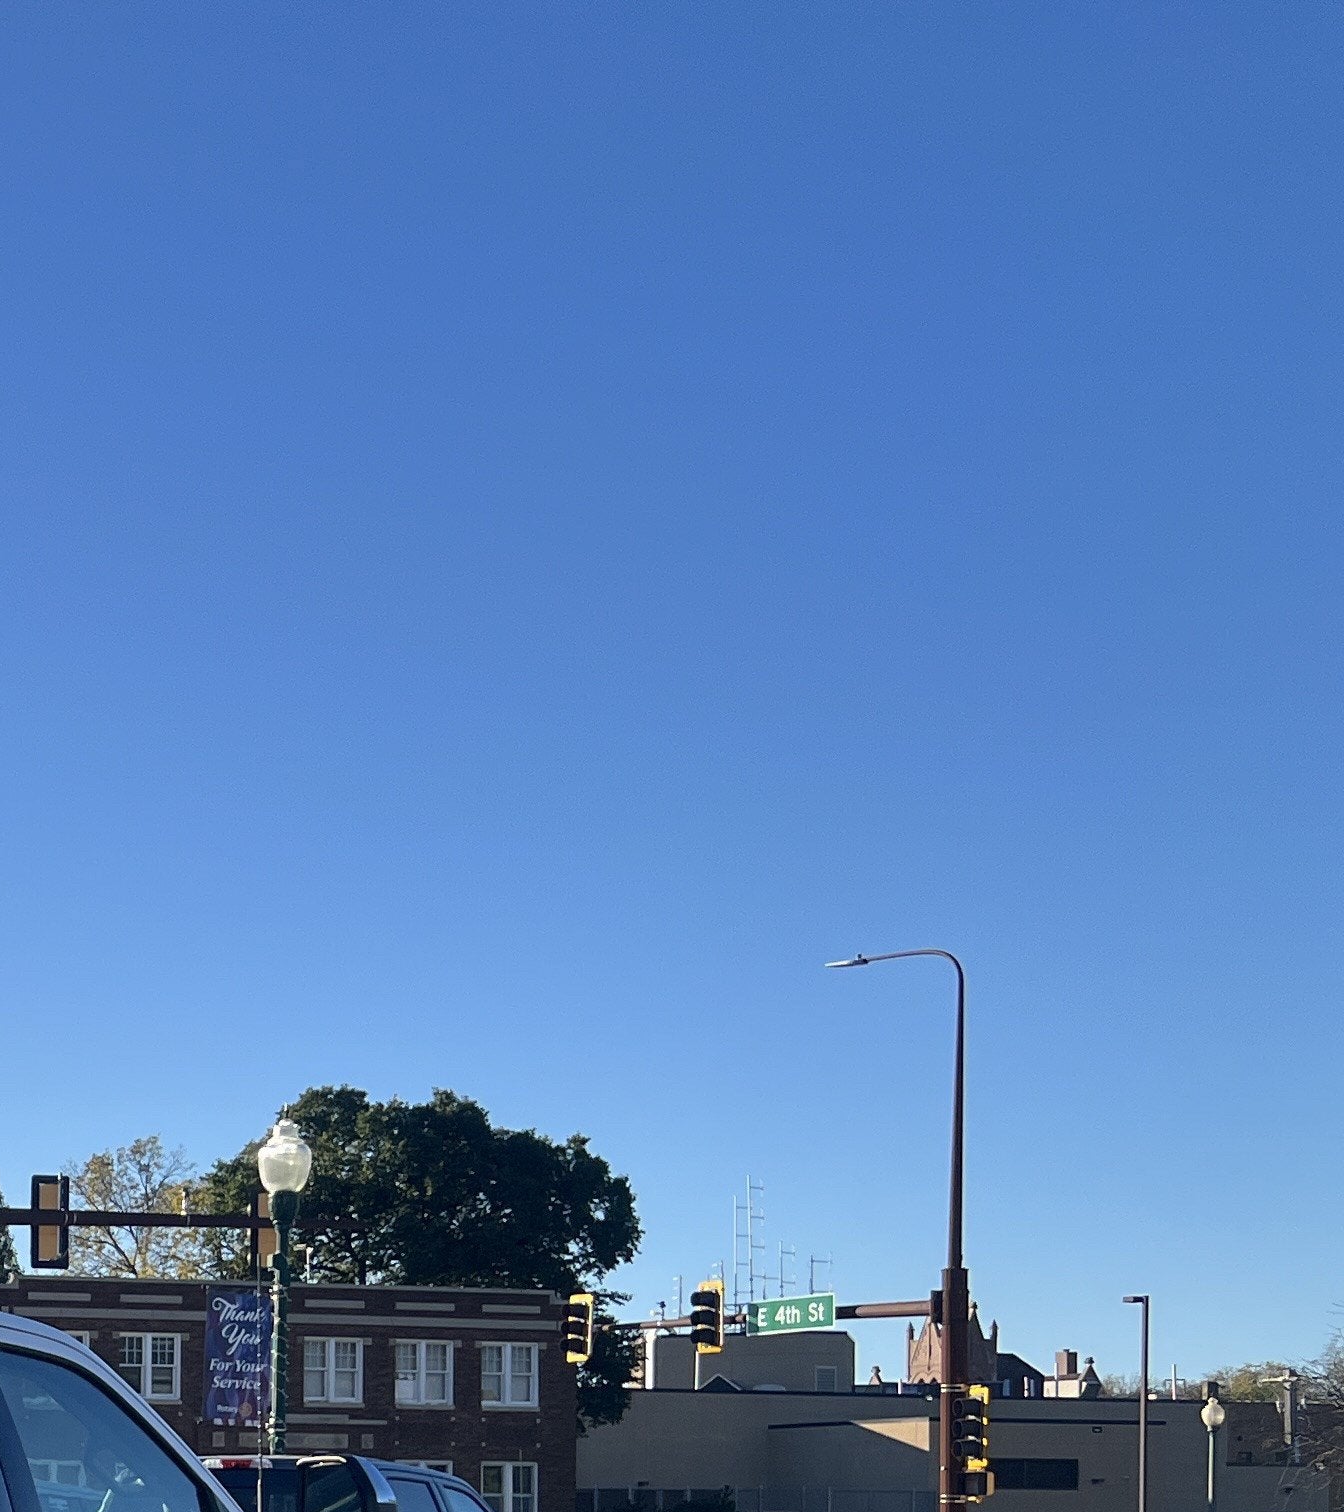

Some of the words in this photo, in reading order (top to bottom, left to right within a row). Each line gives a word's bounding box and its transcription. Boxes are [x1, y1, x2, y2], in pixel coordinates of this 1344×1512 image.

[212, 1297, 266, 1322] Thank
[757, 1307, 768, 1327] E
[775, 1305, 801, 1326] 4th
[808, 1302, 825, 1322] St
[221, 1323, 262, 1356] You
[209, 1358, 233, 1371] For
[234, 1360, 268, 1372] Your
[212, 1375, 261, 1389] Service
